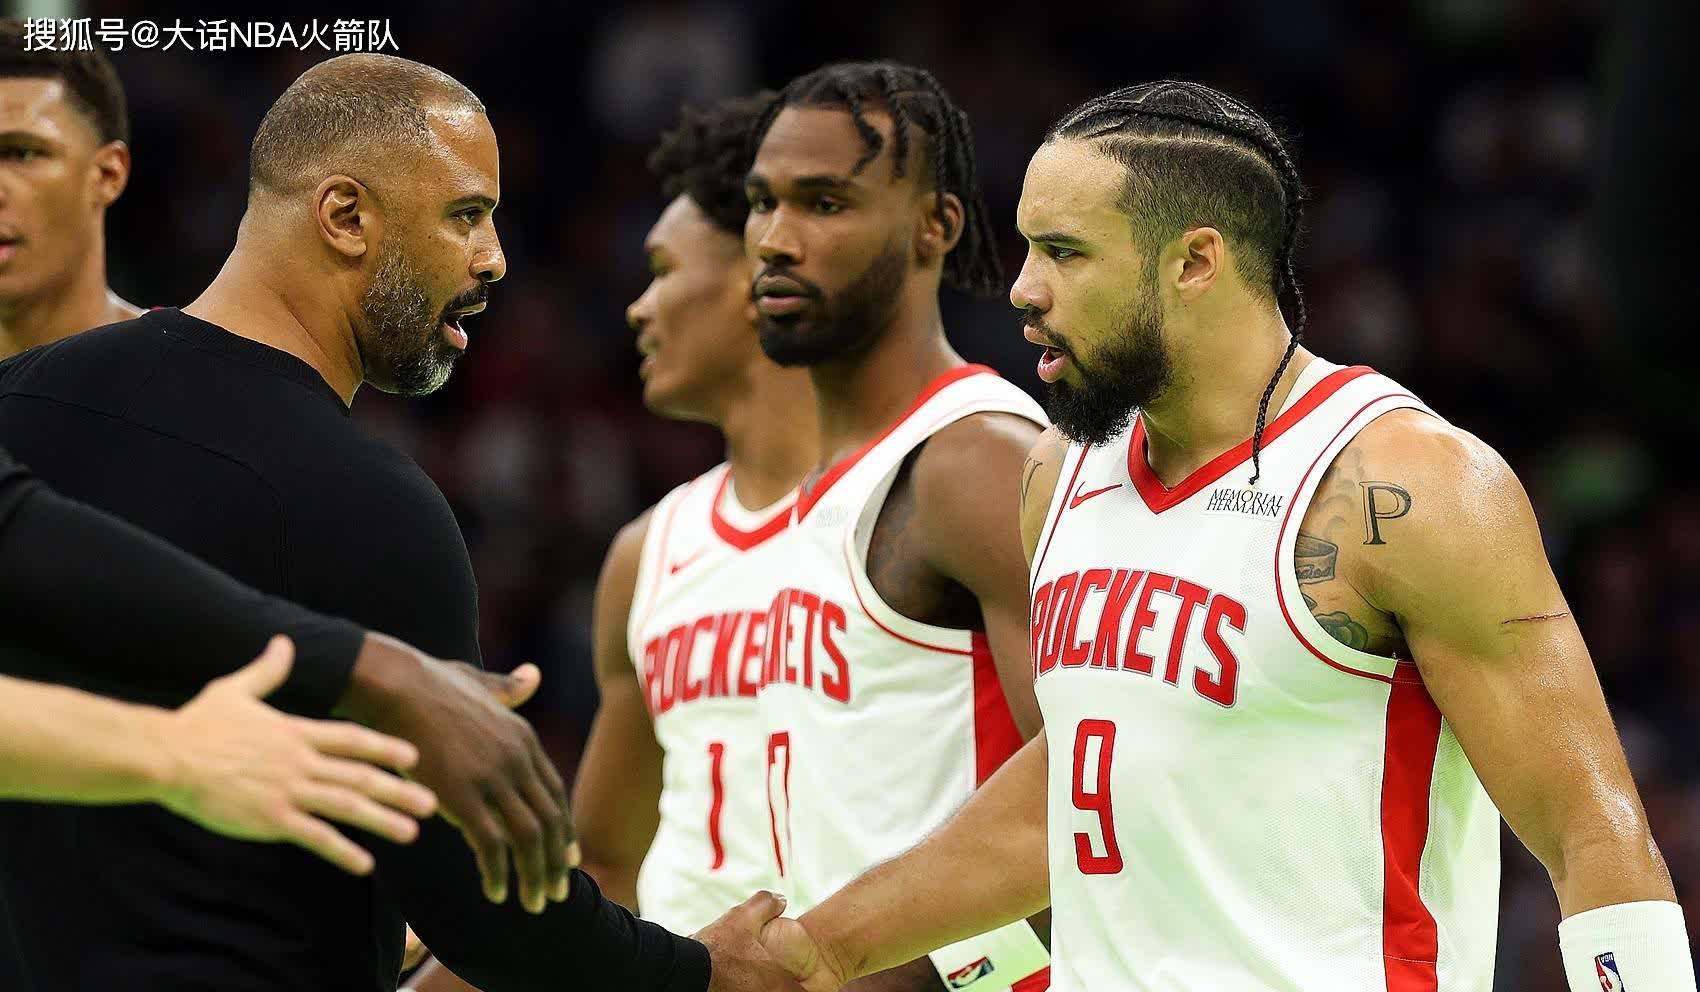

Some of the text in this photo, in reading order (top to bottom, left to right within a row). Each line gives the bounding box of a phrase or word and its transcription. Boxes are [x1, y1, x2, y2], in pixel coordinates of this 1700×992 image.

[1206, 498, 1282, 517] HERMANN
[1210, 488, 1283, 507] MEMORIAL
[1359, 480, 1412, 545] P
[1032, 568, 1248, 708] ROCKETS
[709, 743, 723, 869] 1
[1072, 719, 1123, 874] 9
